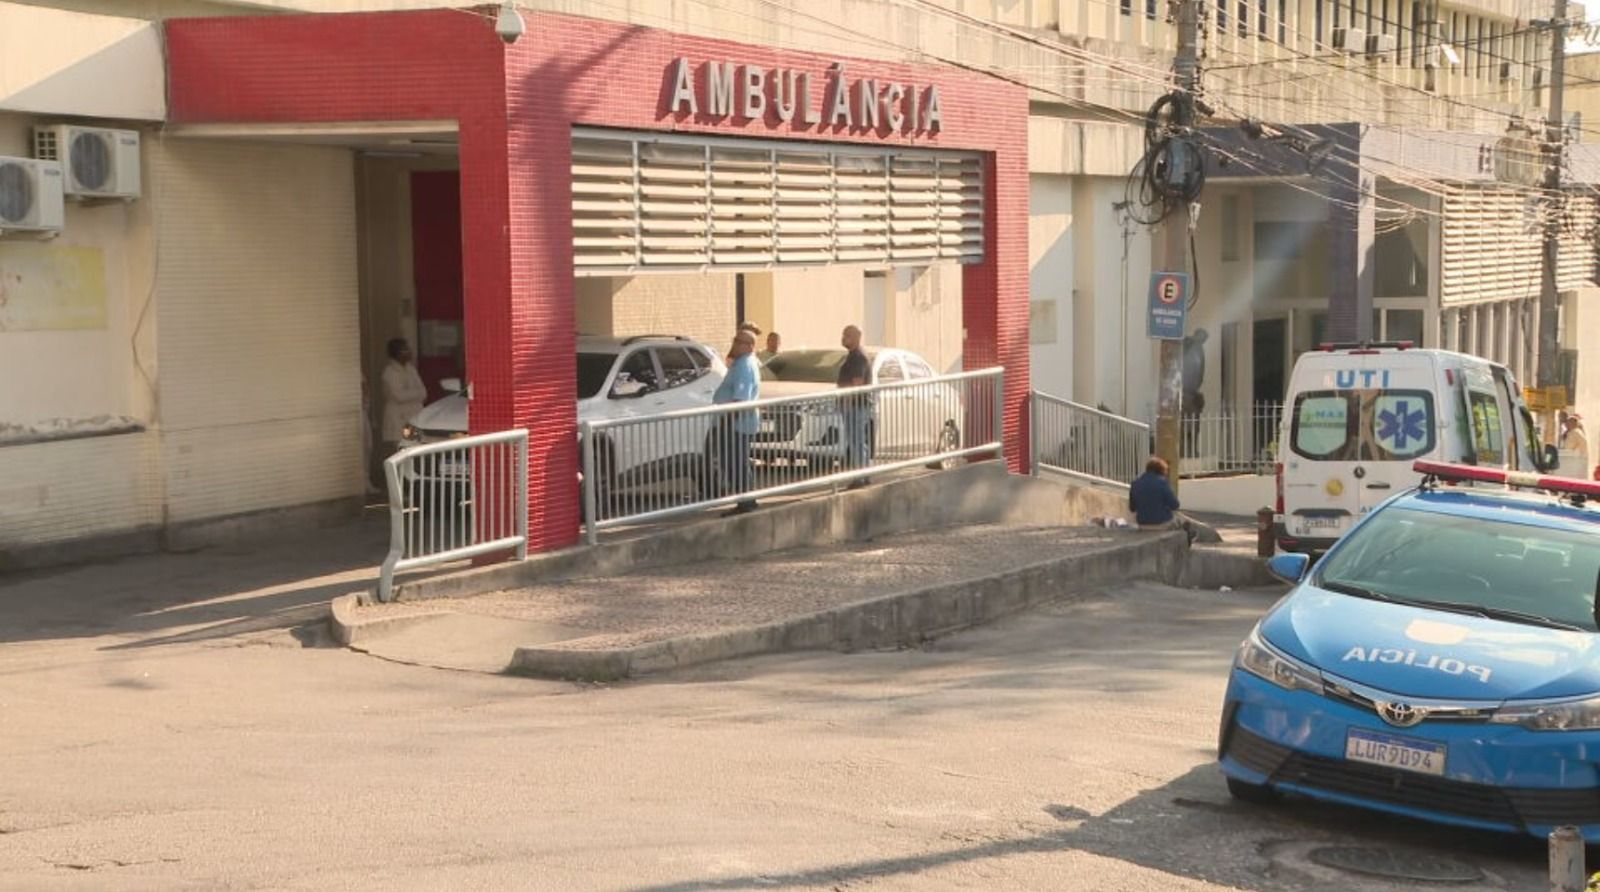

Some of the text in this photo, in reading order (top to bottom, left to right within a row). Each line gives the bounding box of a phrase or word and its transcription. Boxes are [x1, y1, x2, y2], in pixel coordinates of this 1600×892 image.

[671, 57, 943, 133] AMBULÂNCIA
[1164, 283, 1174, 299] E
[1336, 370, 1389, 388] UTI
[1354, 740, 1431, 768] LUR9D94
